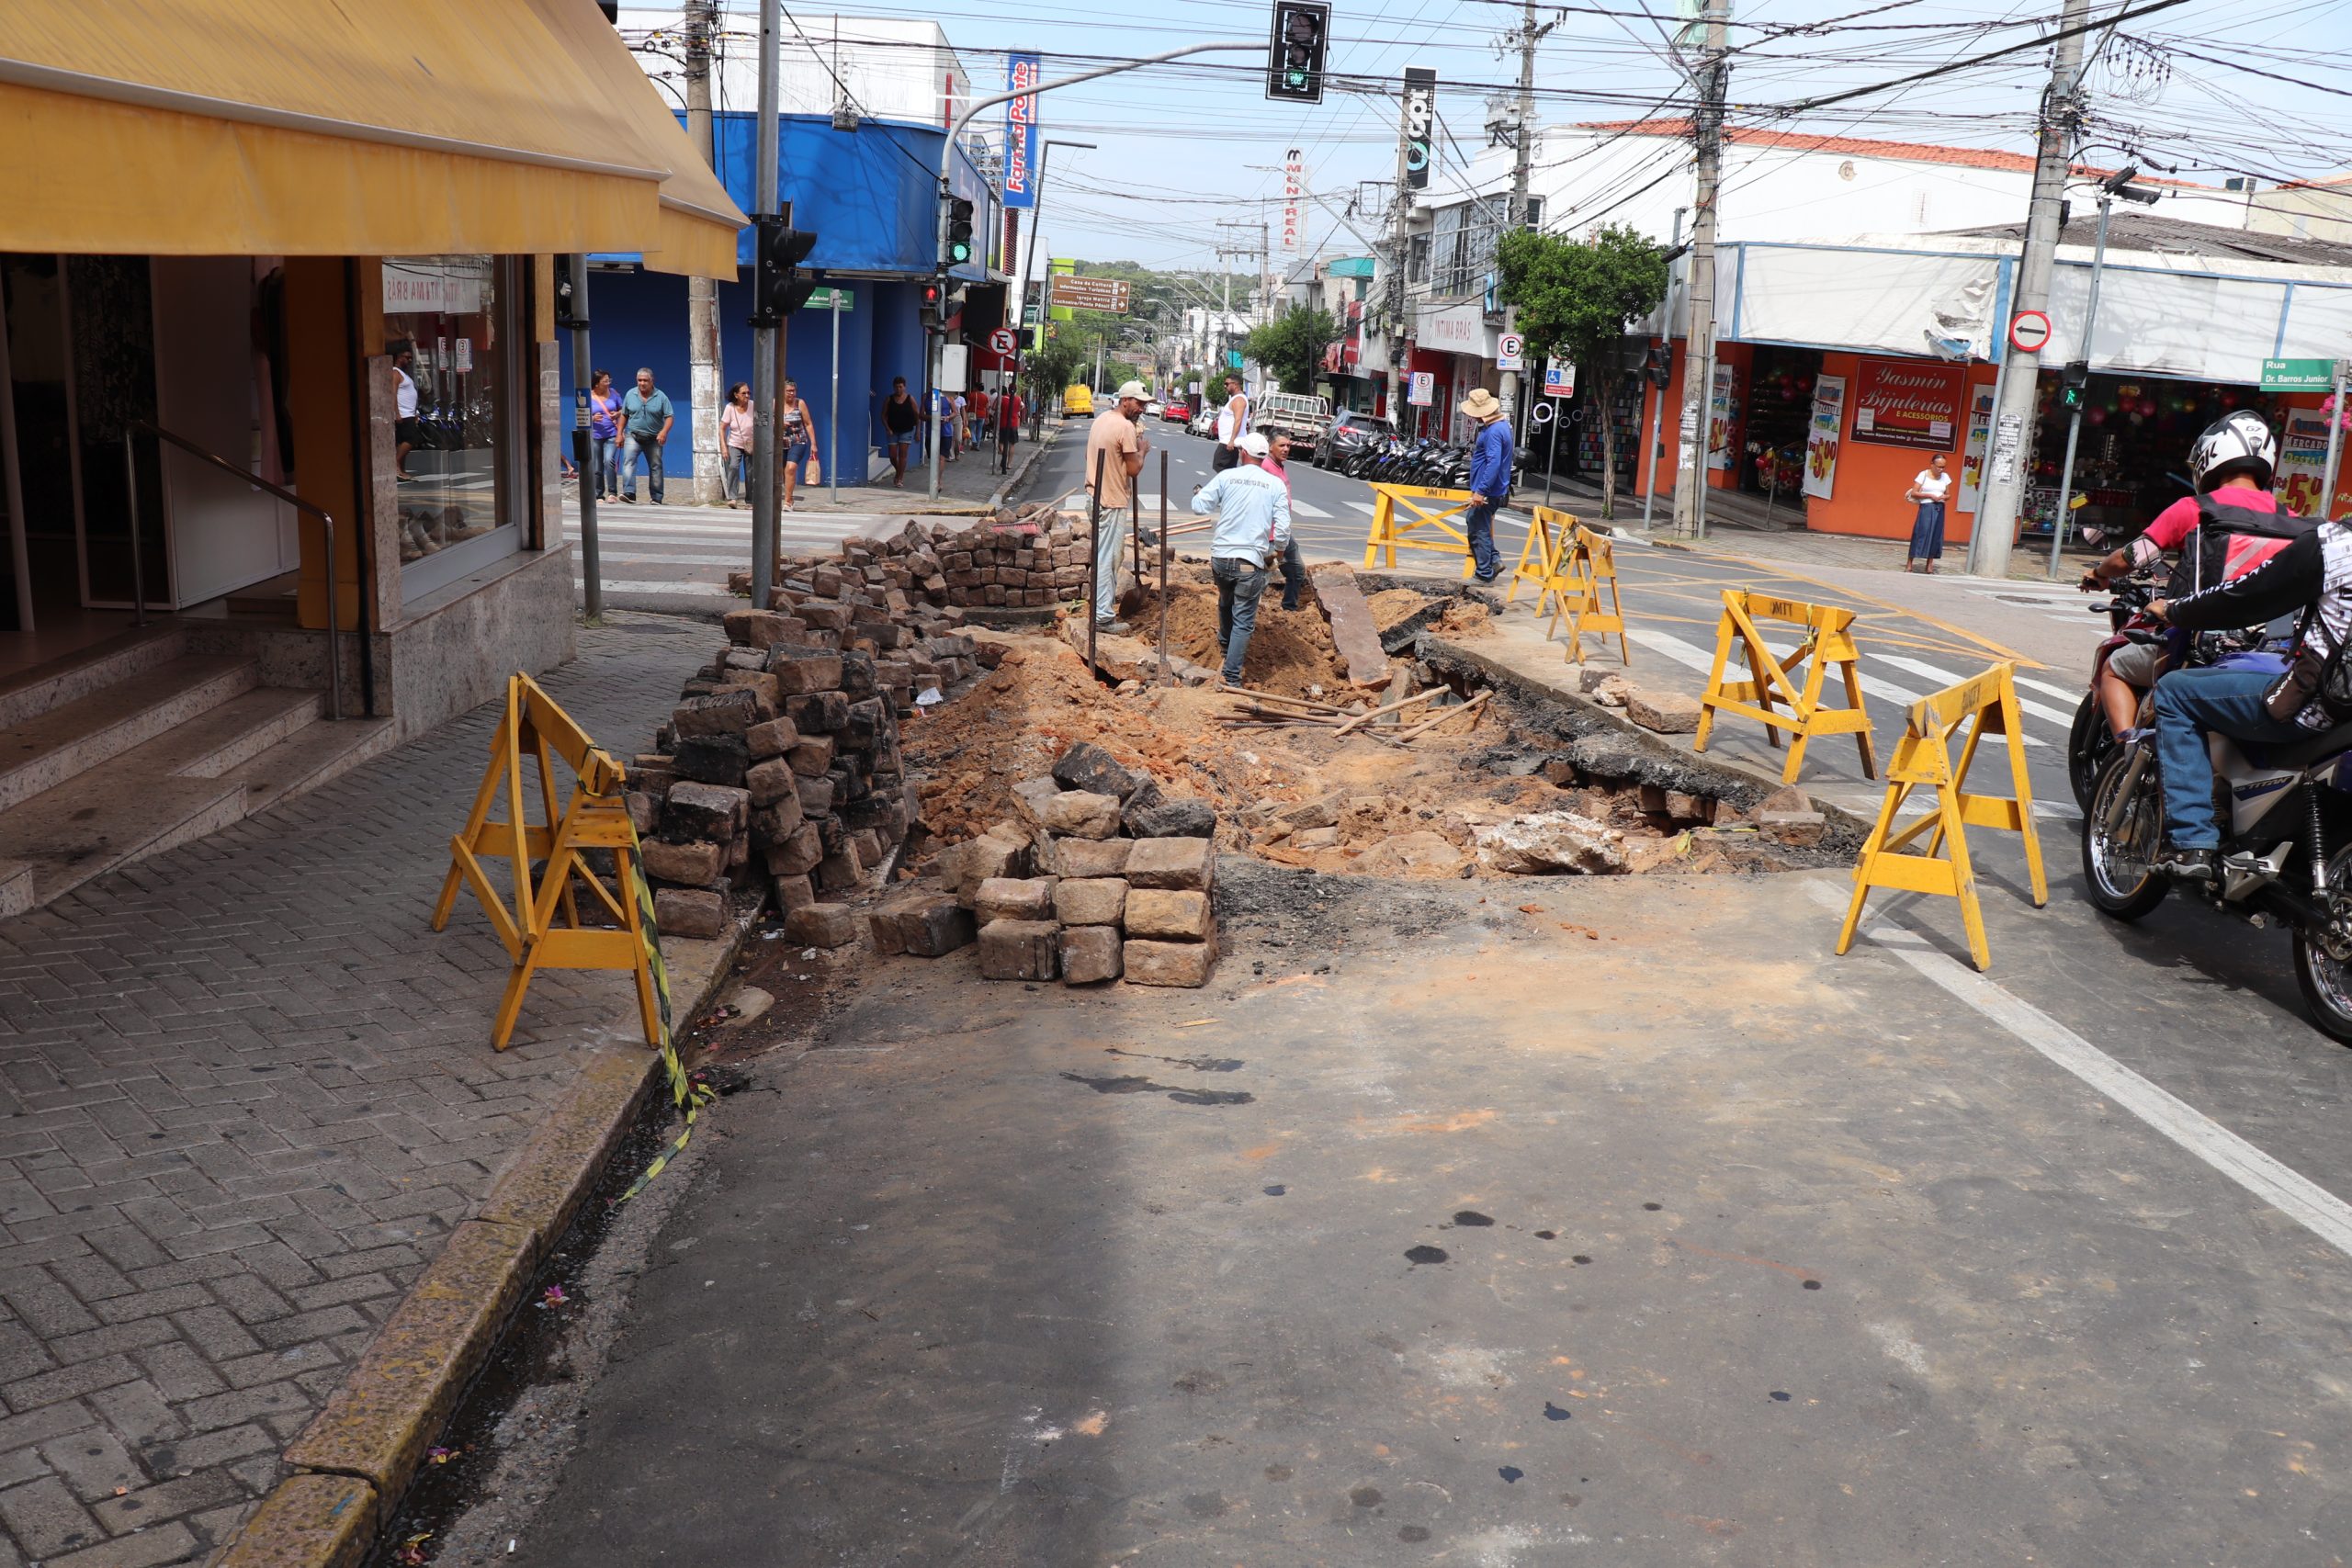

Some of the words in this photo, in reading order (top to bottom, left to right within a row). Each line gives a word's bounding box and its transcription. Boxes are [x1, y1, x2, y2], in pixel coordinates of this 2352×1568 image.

[1507, 341, 1515, 354] E
[2266, 361, 2286, 369] Rua
[1420, 376, 1427, 385] E
[1876, 366, 1947, 389] Yasmin
[2265, 375, 2276, 383] Dr.
[2278, 375, 2302, 383] Barros
[1860, 388, 1952, 415] Bijuterias
[2286, 473, 2335, 517] 5,0
[2248, 777, 2292, 790] TITAN
